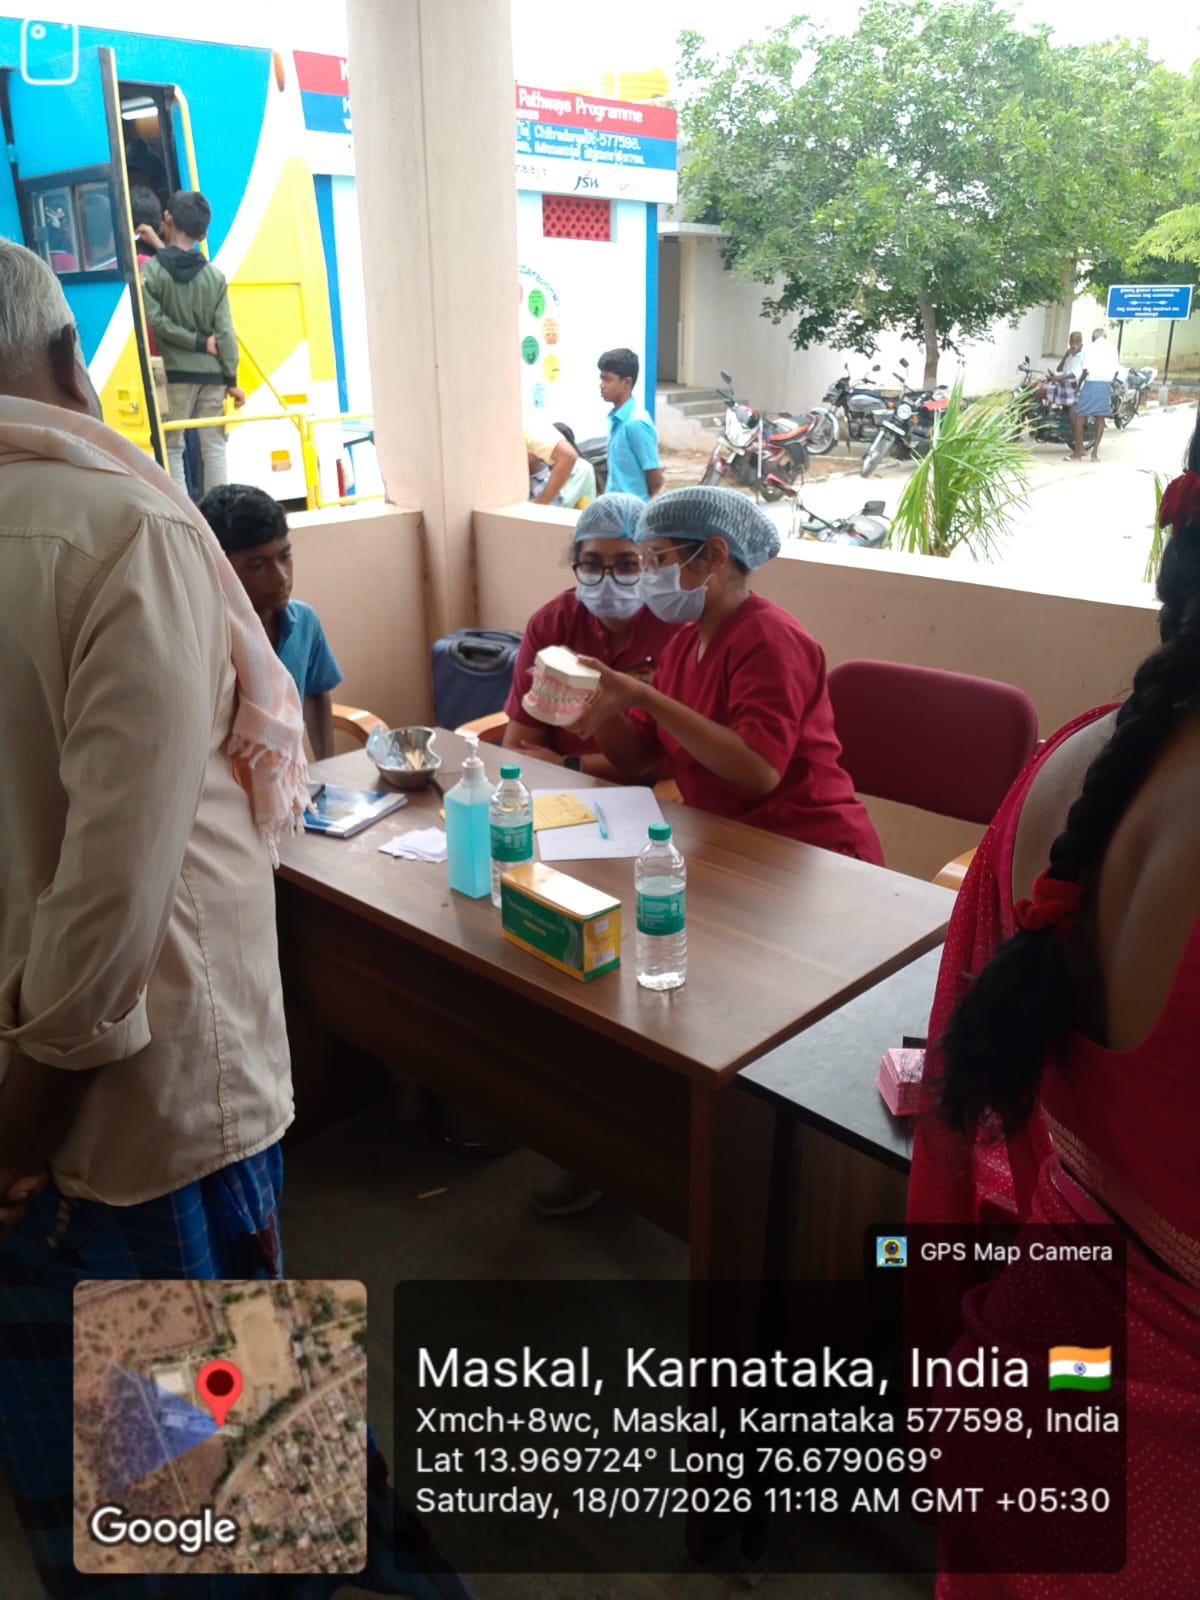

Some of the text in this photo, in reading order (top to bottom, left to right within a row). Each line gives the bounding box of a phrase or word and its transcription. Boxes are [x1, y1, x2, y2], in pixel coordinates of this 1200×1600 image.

[518, 88, 644, 123] Pathways Programme
[573, 175, 600, 191] JSW
